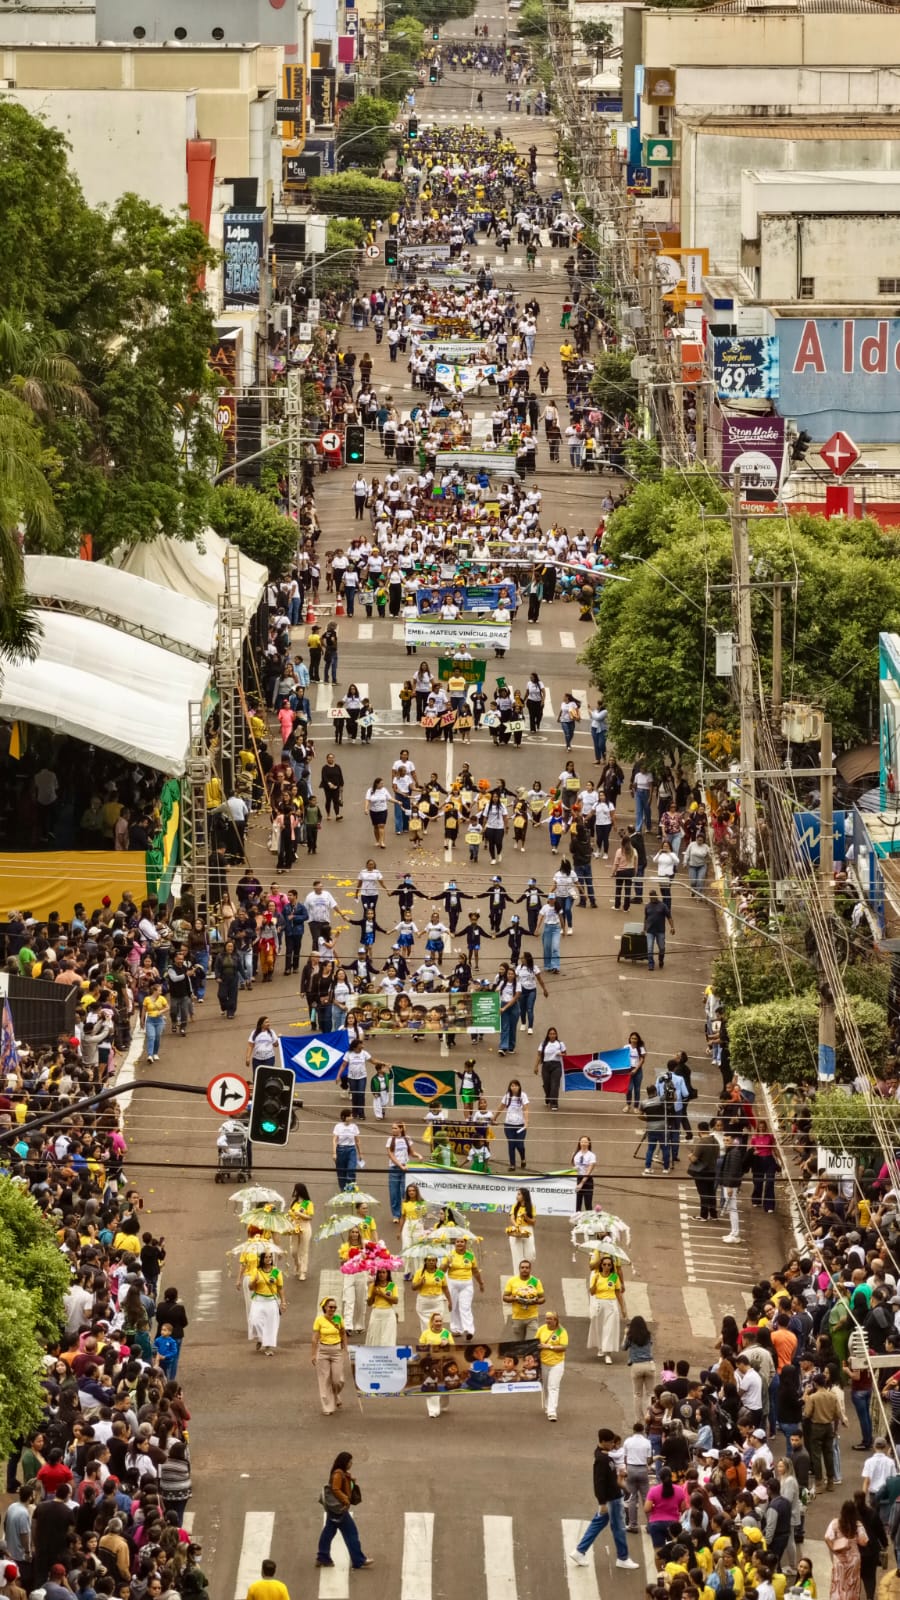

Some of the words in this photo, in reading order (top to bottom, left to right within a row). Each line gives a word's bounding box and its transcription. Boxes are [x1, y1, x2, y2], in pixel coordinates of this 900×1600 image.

[227, 225, 250, 241] Lojas
[509, 721, 521, 731] LO
[828, 1156, 854, 1169] MOTO
